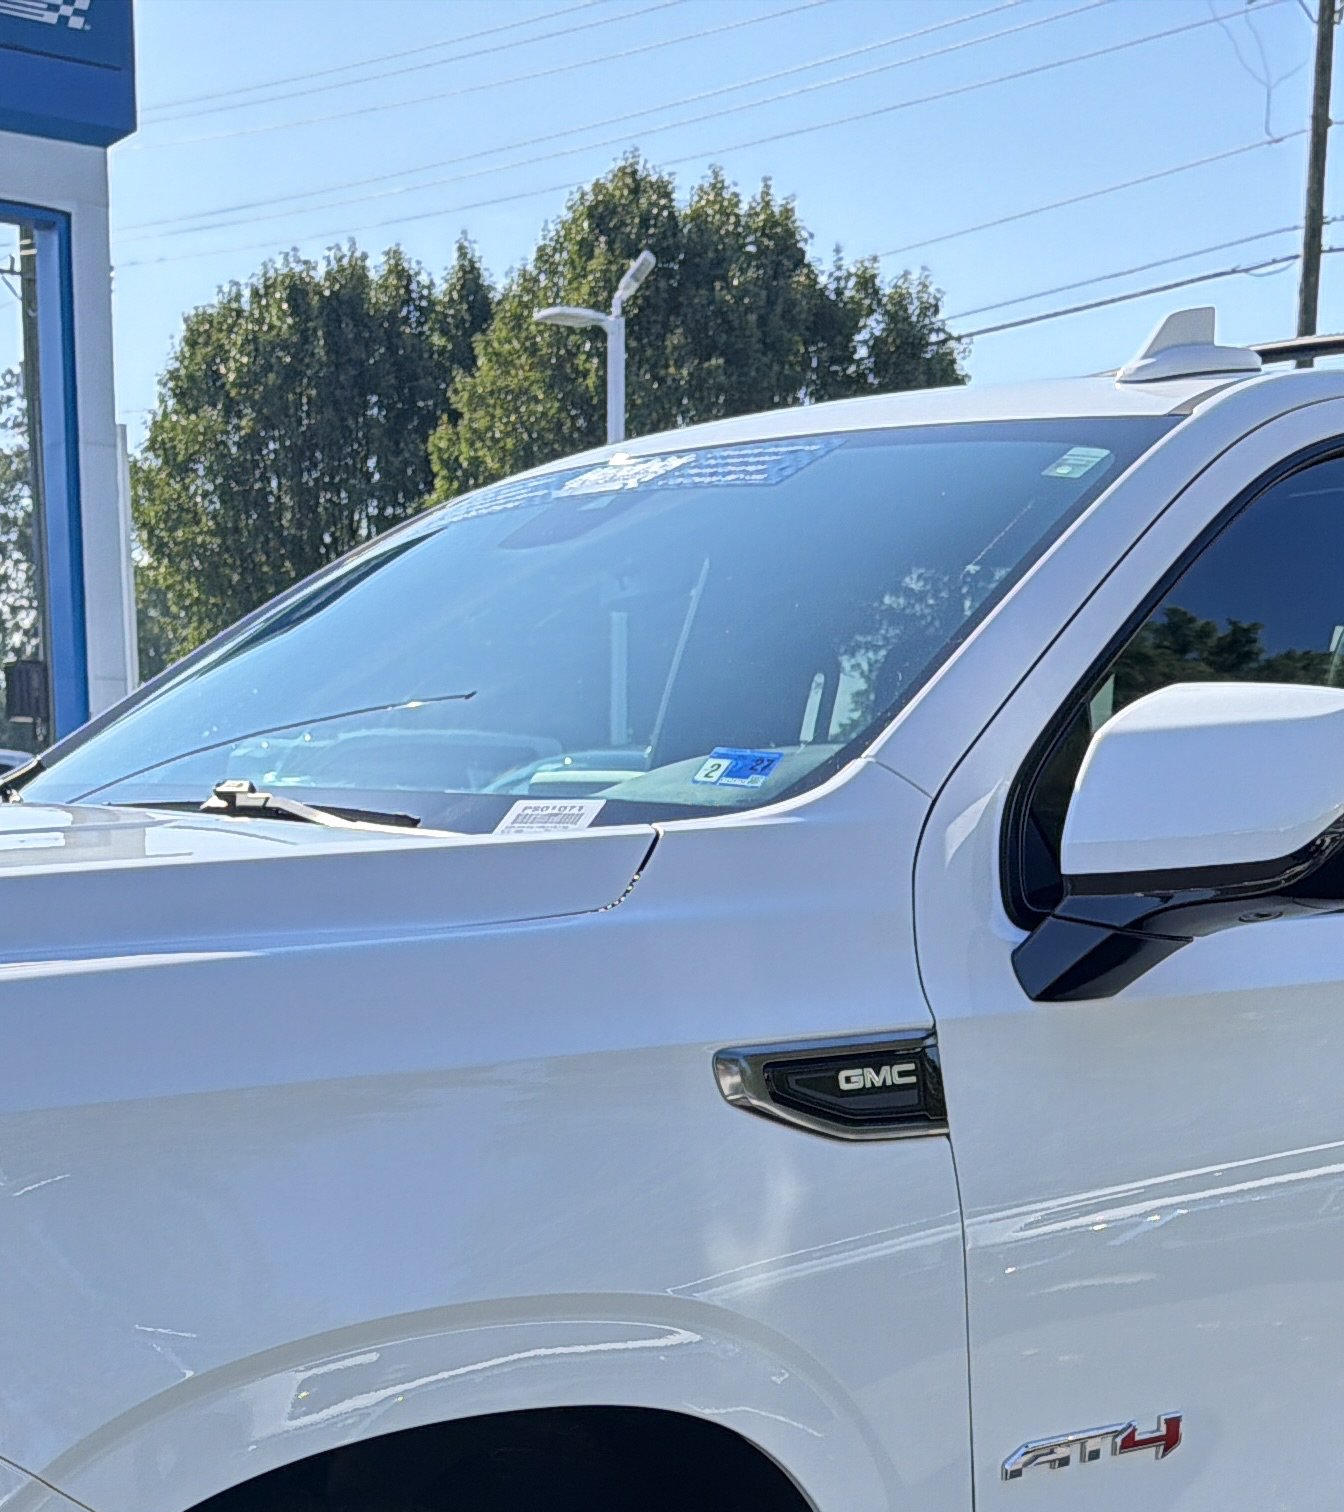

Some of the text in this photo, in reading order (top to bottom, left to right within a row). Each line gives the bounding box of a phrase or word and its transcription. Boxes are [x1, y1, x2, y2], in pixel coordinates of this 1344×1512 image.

[703, 763, 722, 778] 2
[749, 757, 775, 772] 27
[838, 1063, 917, 1091] GMC
[1001, 1410, 1183, 1481] AT4
